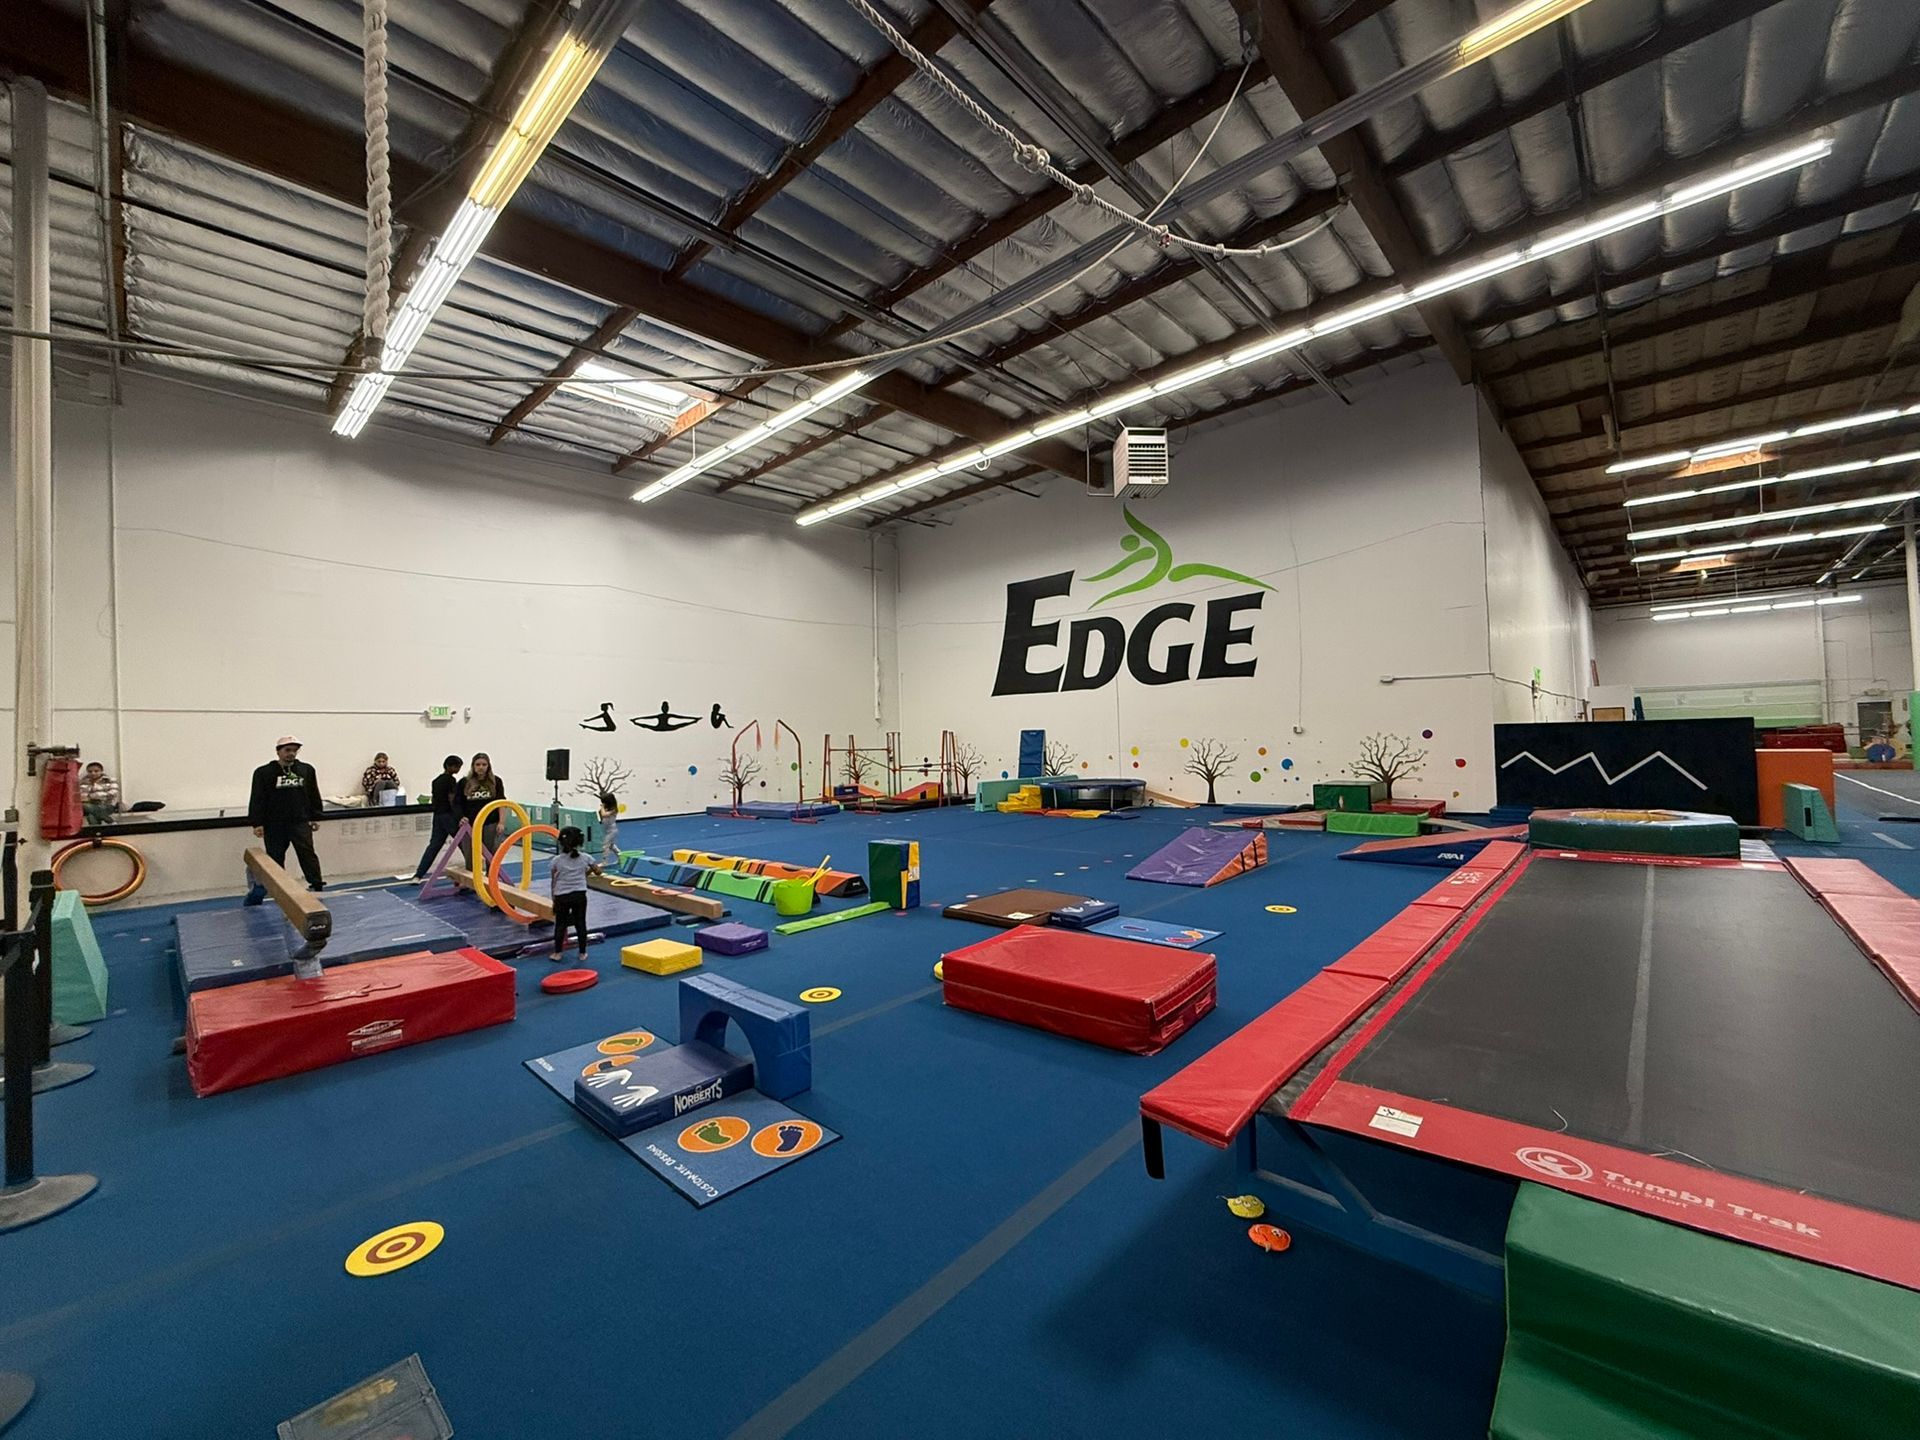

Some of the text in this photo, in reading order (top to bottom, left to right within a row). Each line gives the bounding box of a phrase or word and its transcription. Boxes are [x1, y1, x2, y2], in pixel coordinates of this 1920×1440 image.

[991, 569, 1266, 697] EDGE
[433, 706, 449, 716] EXIT
[646, 1143, 719, 1198] CUSTOMATIC DESIGNS
[1605, 1182, 1688, 1209] Train Smart
[1602, 1169, 1821, 1238] Tumbl Trak
